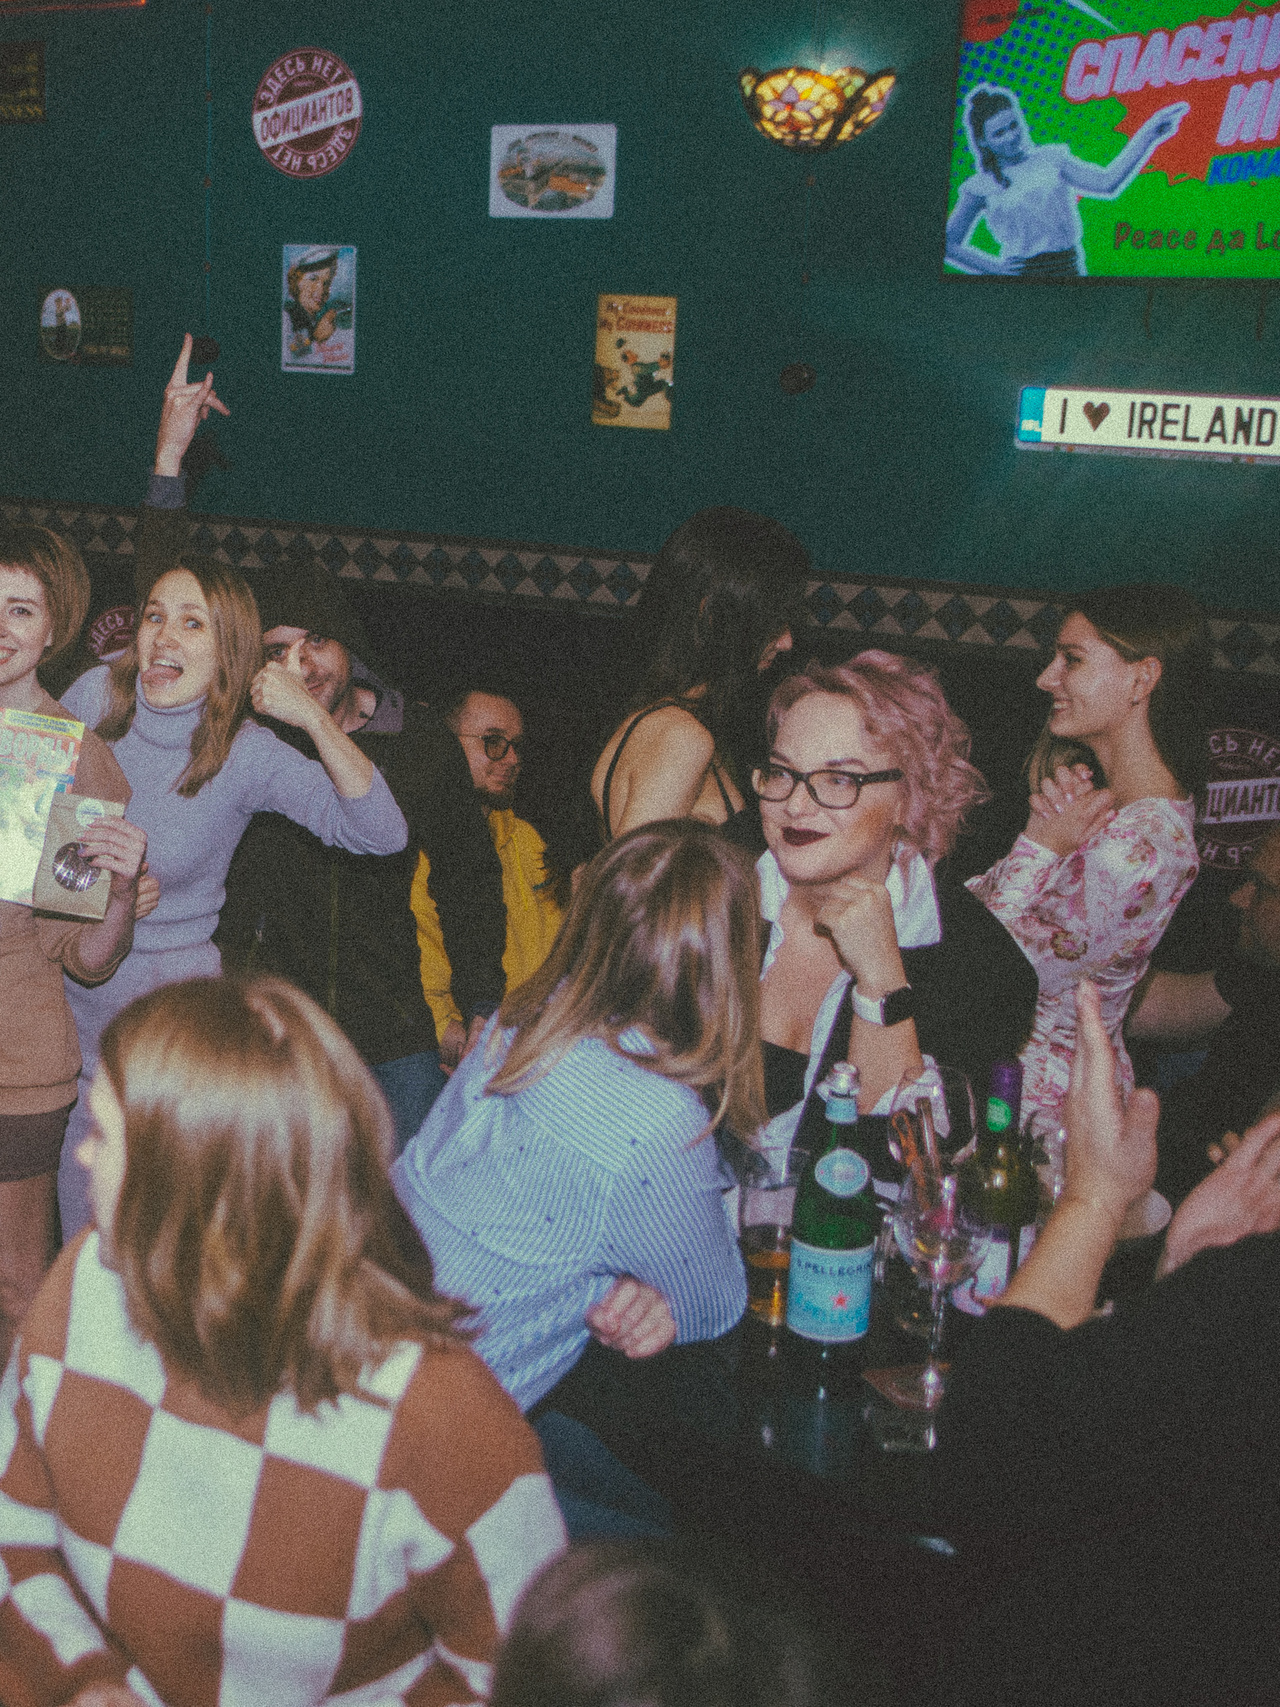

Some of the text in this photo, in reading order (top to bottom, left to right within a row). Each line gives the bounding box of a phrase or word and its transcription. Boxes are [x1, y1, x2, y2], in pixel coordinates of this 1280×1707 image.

[260, 55, 342, 104] ЗДЕСЬ НЕТ
[260, 86, 354, 142] ОФИЦИАНТОВ
[272, 125, 352, 171] ЗДЕСЬ НЕТ
[1115, 222, 1198, 250] Peace
[1206, 229, 1245, 255] да
[1059, 398, 1278, 447] I IRELAND
[1206, 784, 1280, 818] ЦИАНТ
